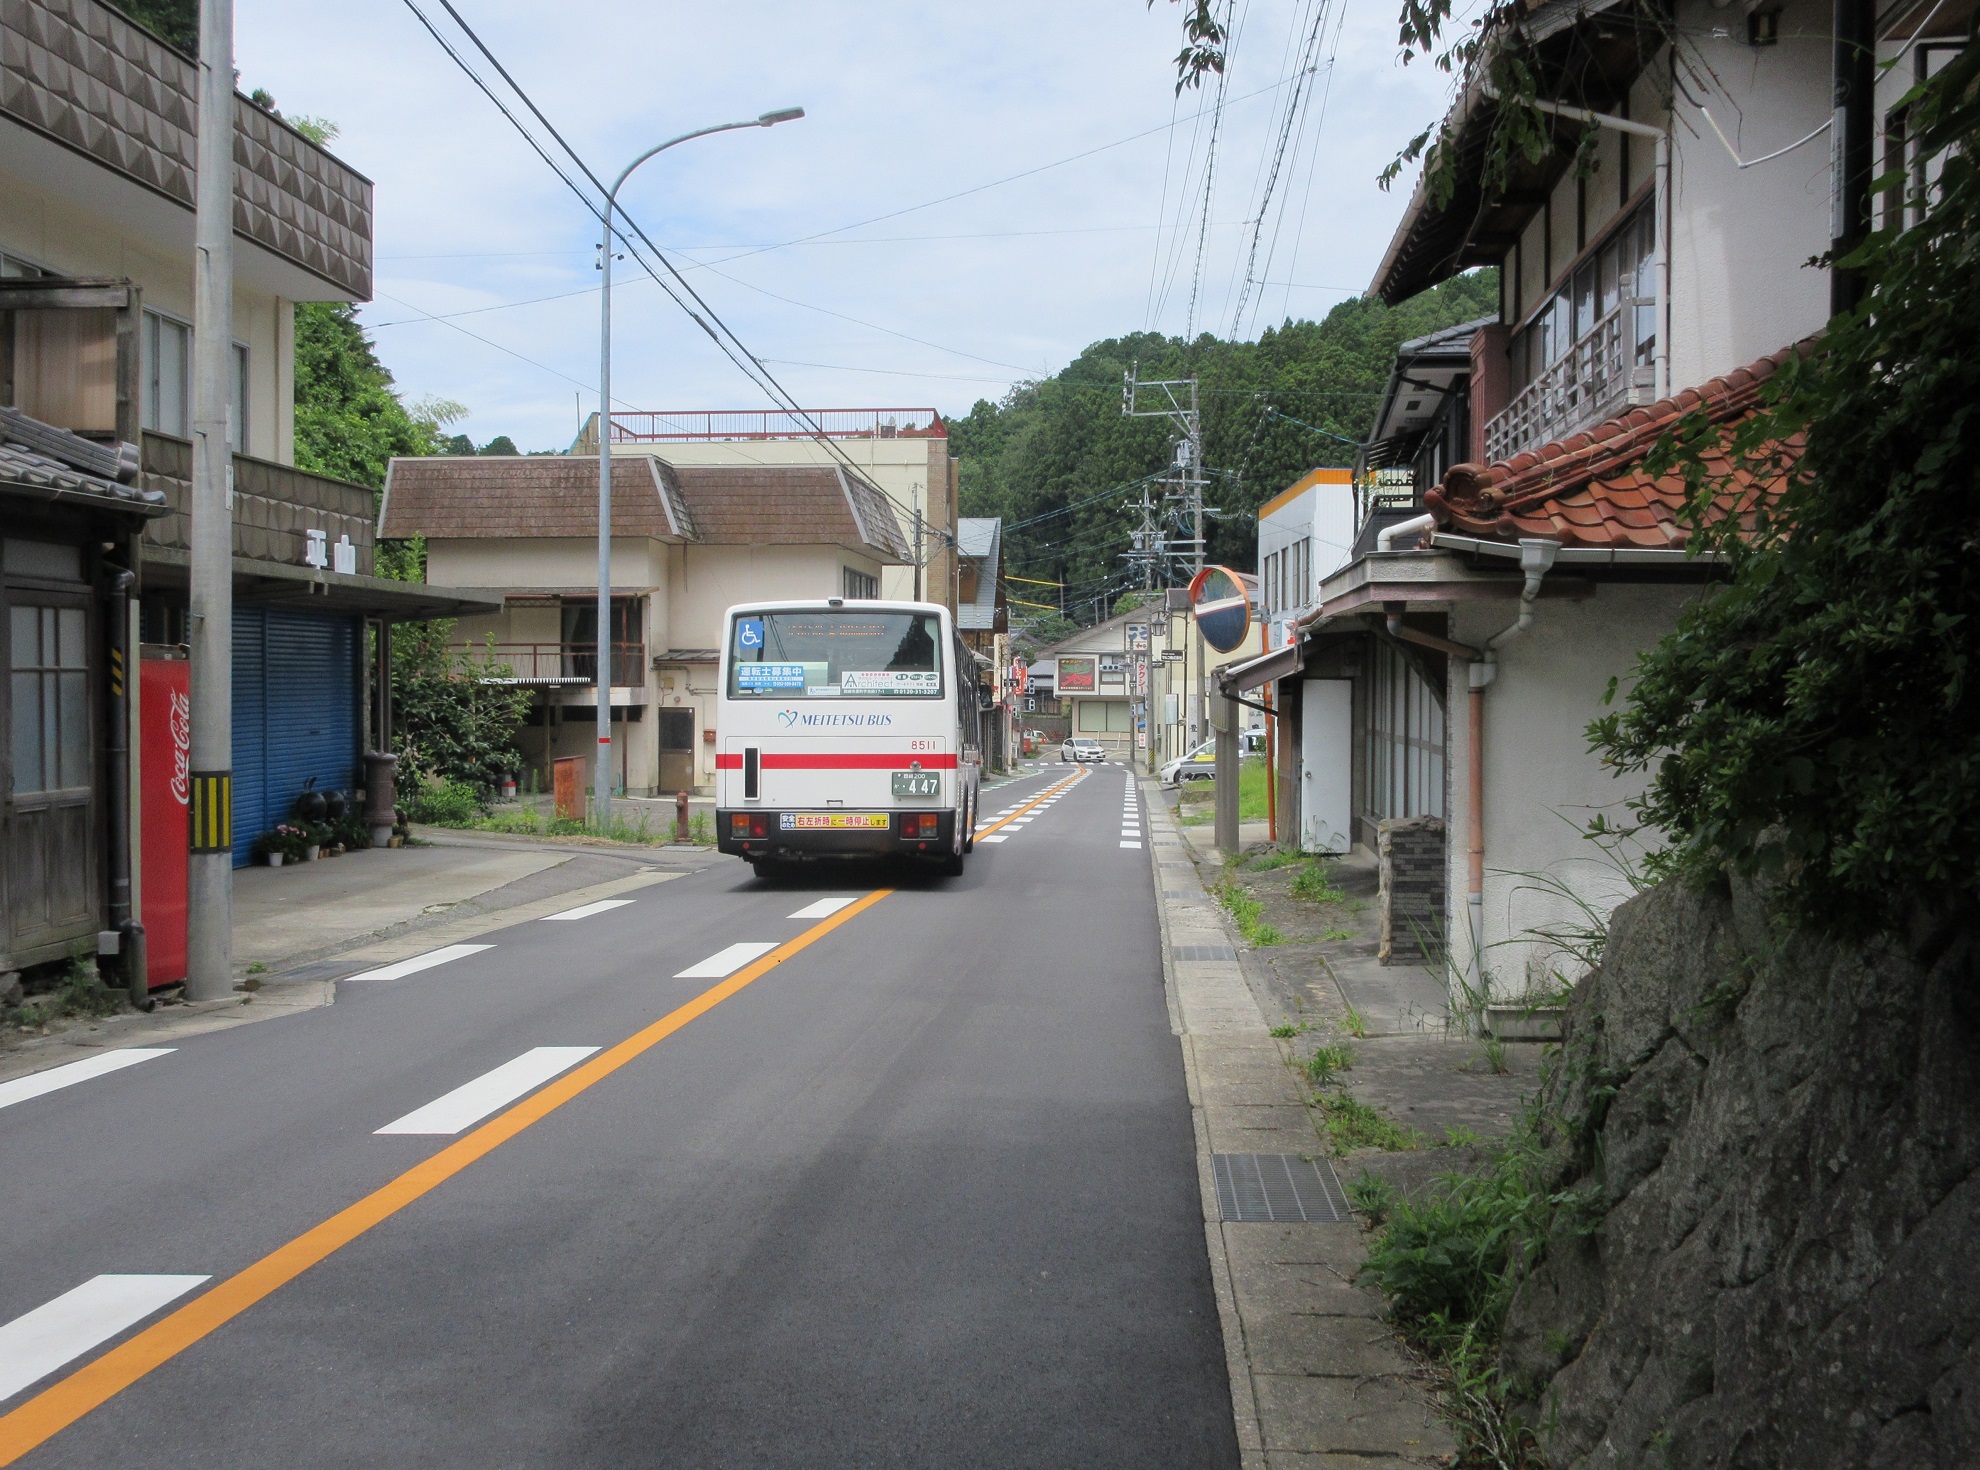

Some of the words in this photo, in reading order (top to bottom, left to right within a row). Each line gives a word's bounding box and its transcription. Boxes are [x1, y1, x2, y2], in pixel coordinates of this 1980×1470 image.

[741, 667, 802, 677] 運転士募集中
[1138, 663, 1146, 694] タクシー
[801, 713, 865, 726] MEITETSU
[866, 713, 893, 726] BUS
[911, 740, 937, 750] 8511
